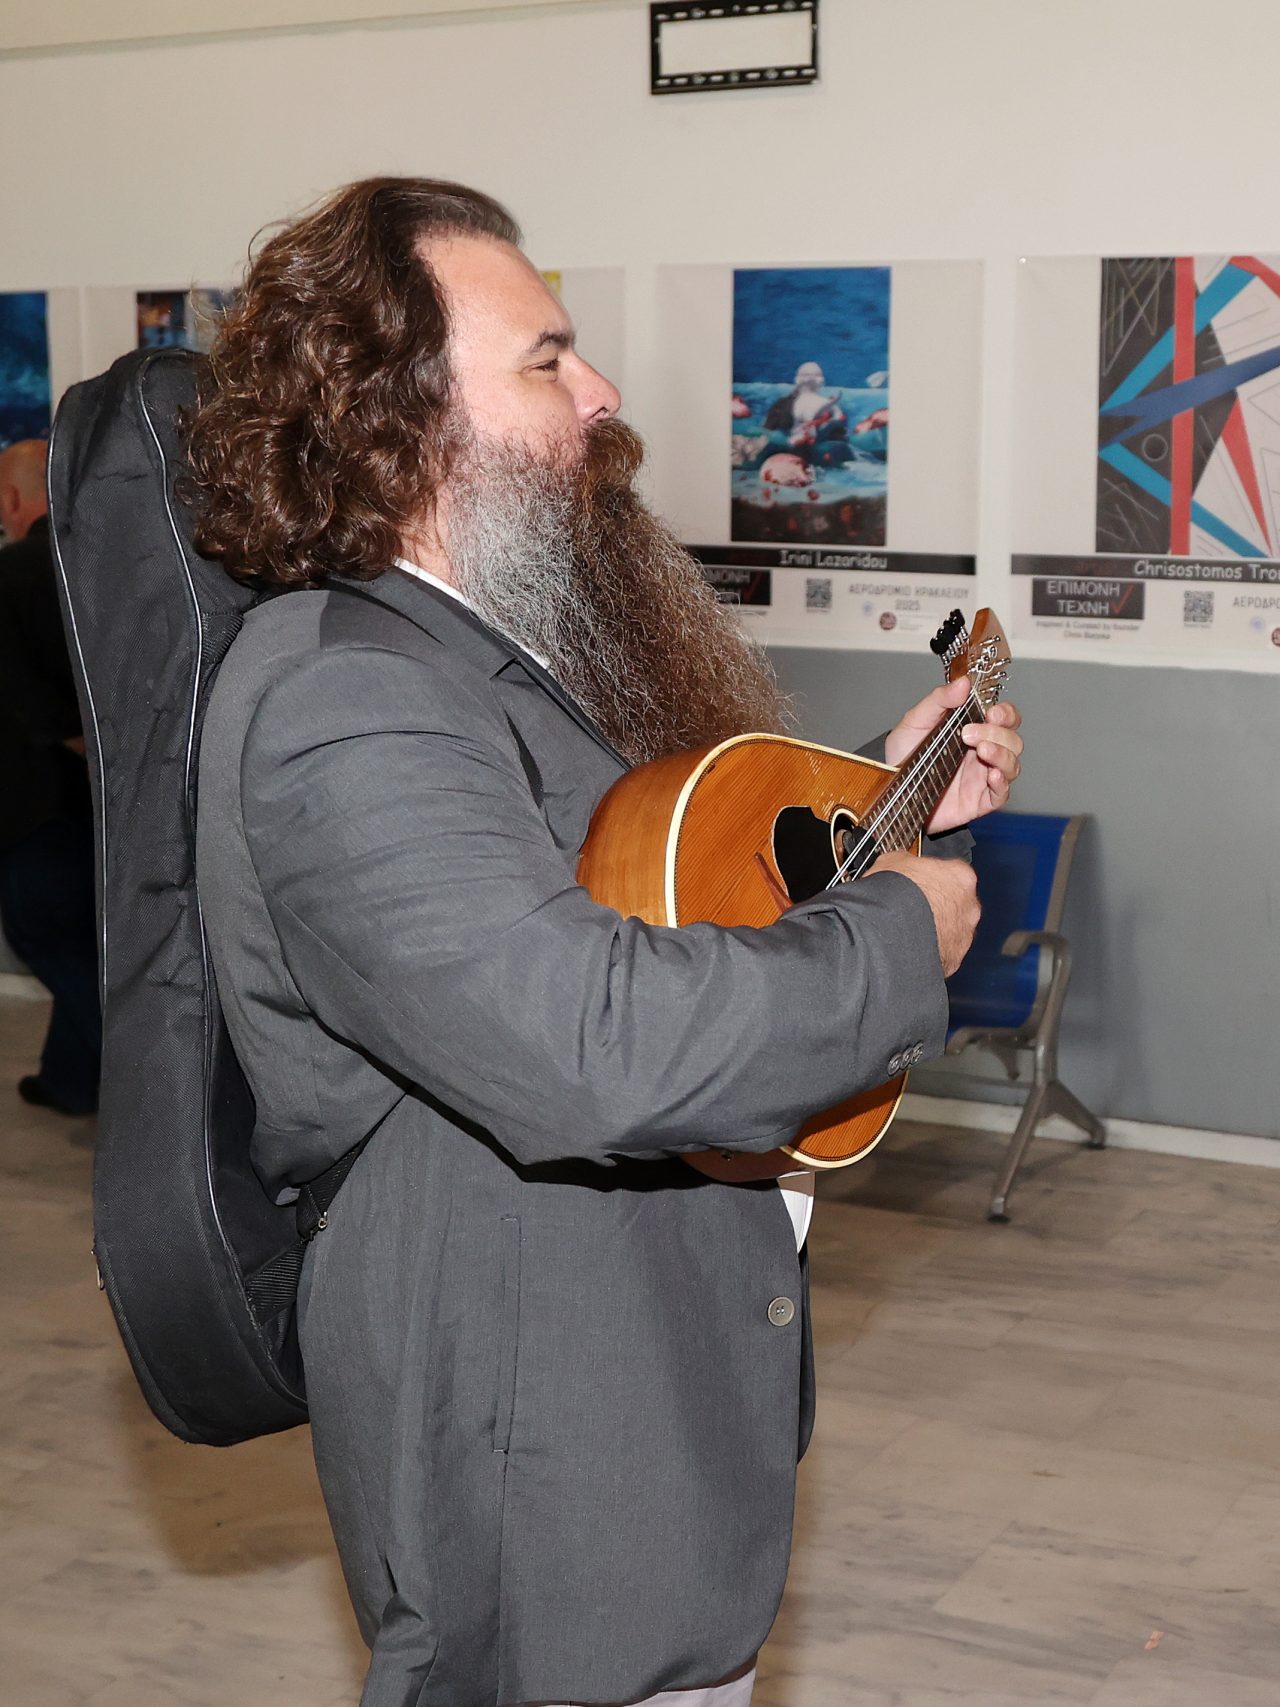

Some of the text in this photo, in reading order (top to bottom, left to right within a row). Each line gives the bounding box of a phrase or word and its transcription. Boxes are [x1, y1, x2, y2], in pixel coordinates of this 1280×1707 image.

[780, 549, 888, 569] Irini Lazaridou
[1133, 559, 1242, 579] Chrisostomos
[1046, 580, 1120, 597] ΕΠΙΜΟΝΗ
[1056, 599, 1110, 615] ΤΕΧΝΗ
